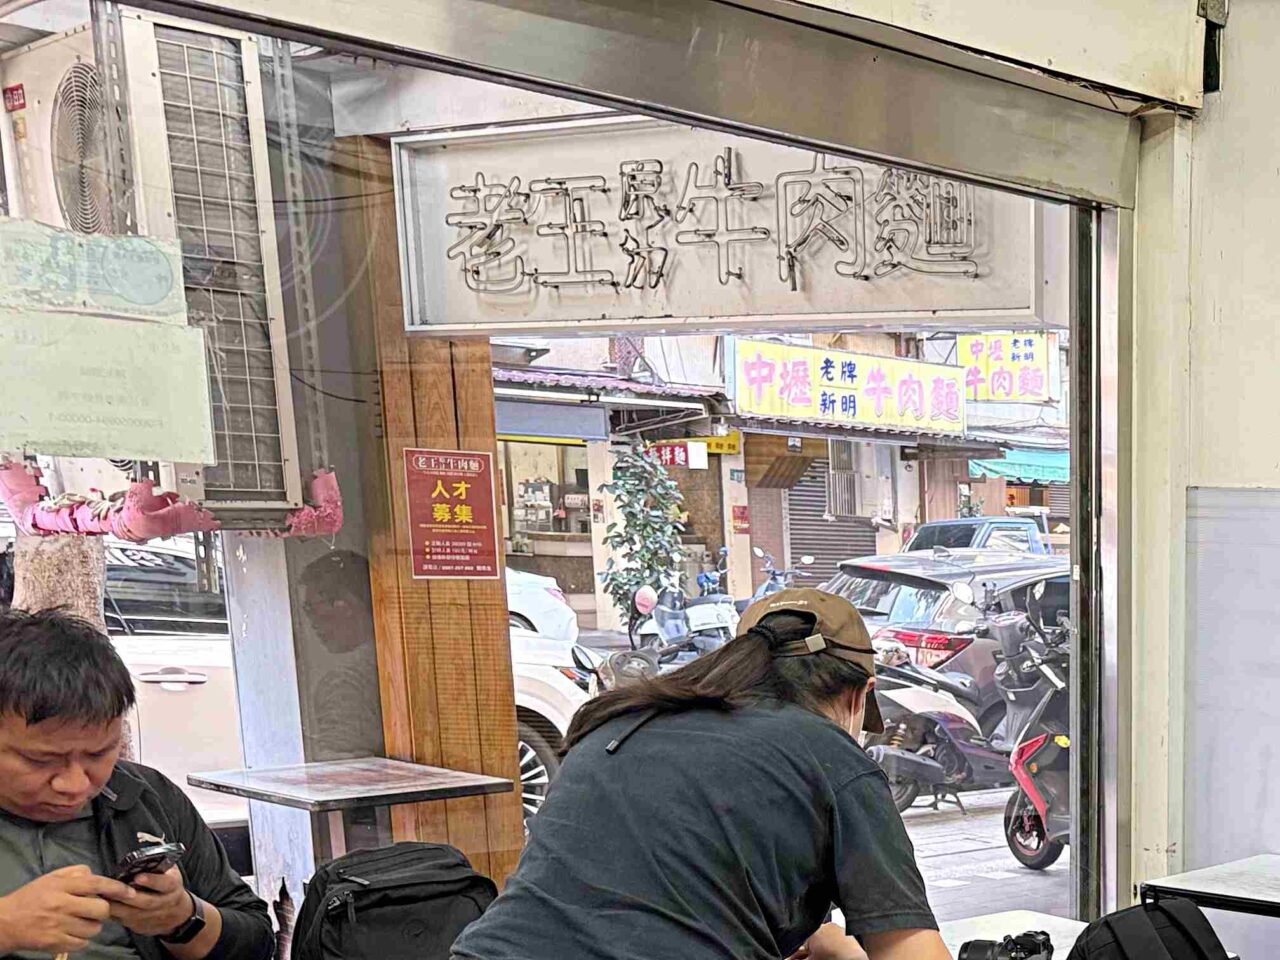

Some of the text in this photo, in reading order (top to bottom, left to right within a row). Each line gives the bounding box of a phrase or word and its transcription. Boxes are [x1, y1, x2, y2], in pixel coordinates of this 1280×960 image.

[743, 350, 812, 406] 中壢
[819, 357, 858, 385] 老牌
[966, 366, 1044, 400] 牛肉麵
[819, 390, 858, 417] 新明
[862, 366, 961, 423] 牛肉麵
[431, 479, 471, 500] 人才
[432, 503, 473, 523] 募集
